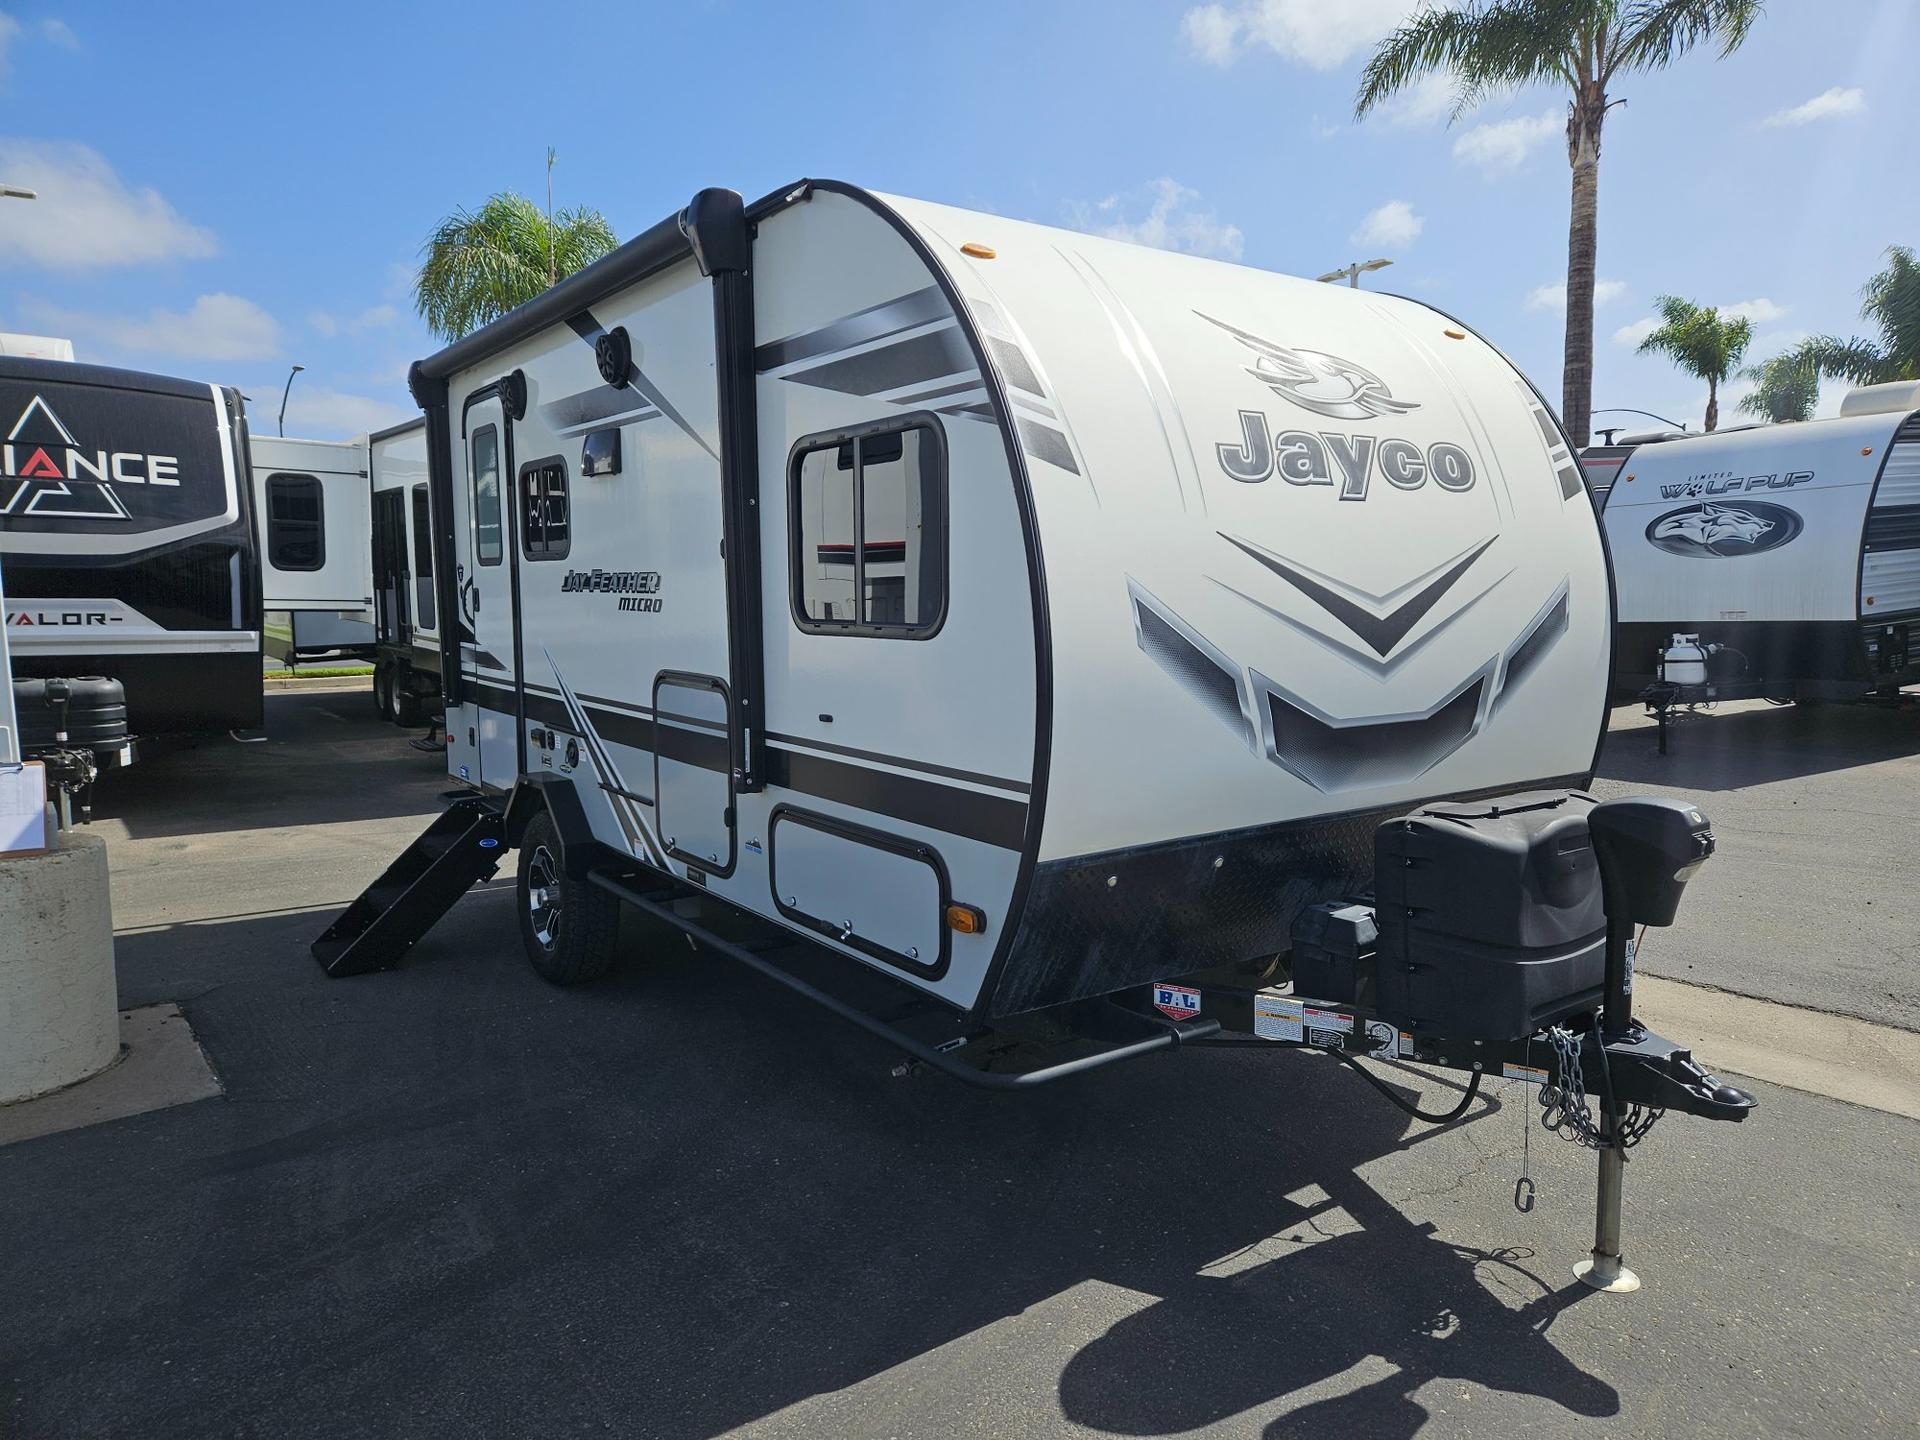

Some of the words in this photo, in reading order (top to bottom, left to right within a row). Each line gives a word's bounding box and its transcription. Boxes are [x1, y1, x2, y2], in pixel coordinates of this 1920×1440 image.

[0, 444, 181, 486] IANCE
[1215, 409, 1476, 501] Jayco
[1688, 472, 1732, 481] LIMITED
[1745, 470, 1815, 491] PUP
[618, 597, 662, 612] MICRO
